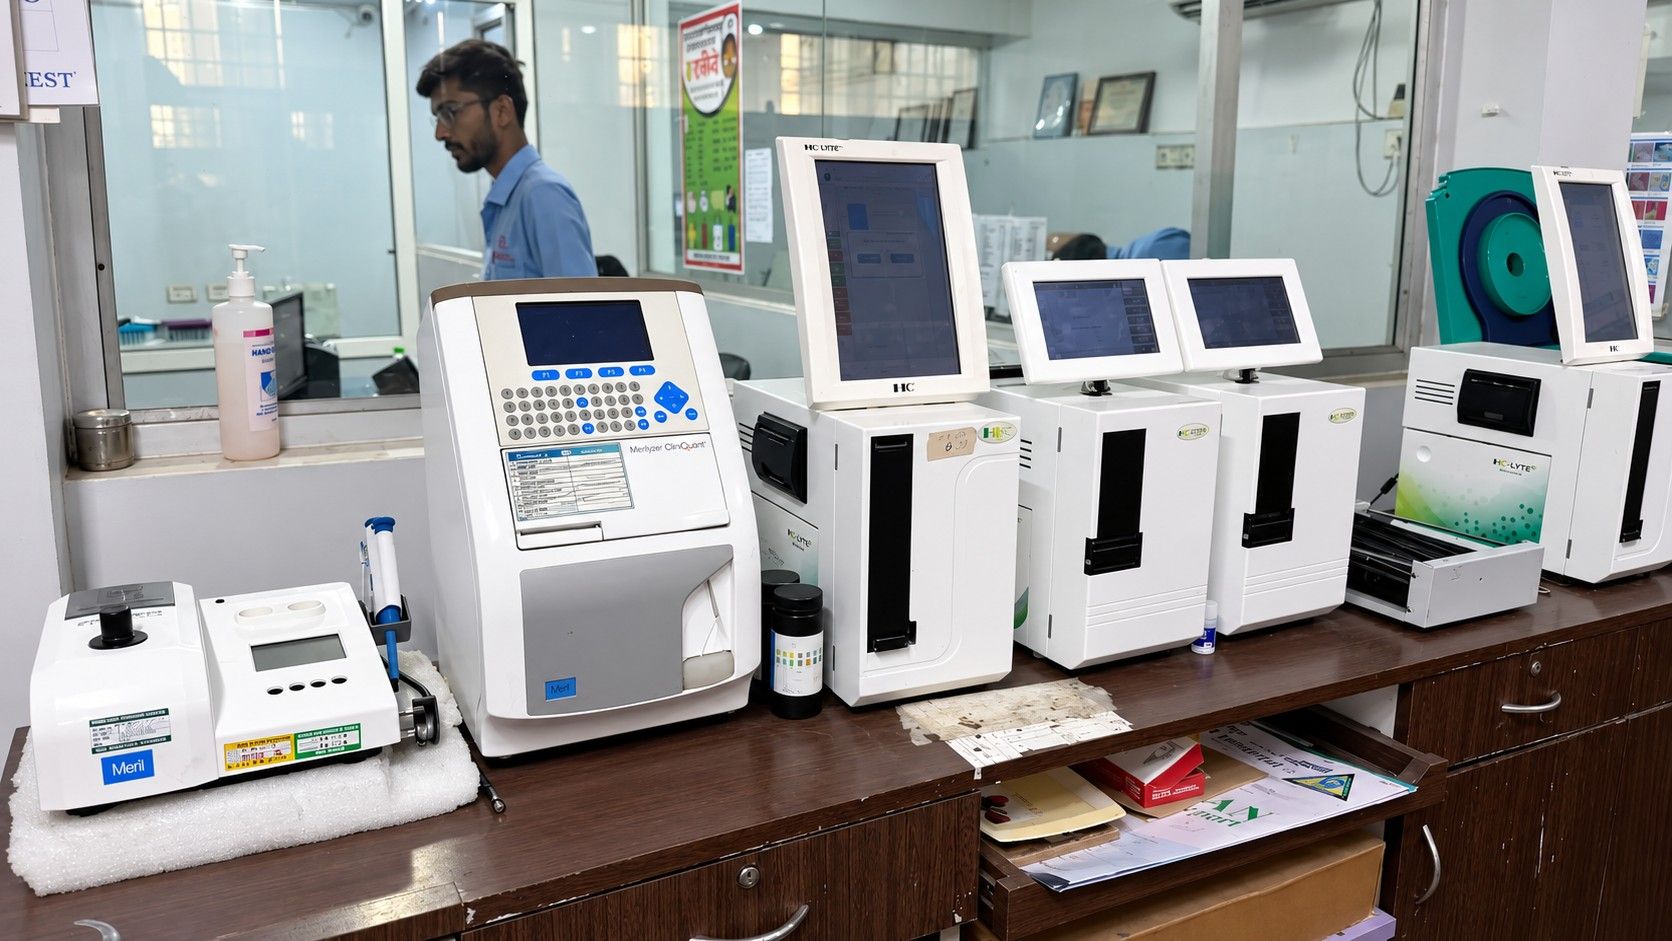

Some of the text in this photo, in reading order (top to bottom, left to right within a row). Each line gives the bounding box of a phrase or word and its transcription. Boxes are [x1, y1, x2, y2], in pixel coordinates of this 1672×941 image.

[24, 71, 73, 88] EST
[893, 382, 915, 393] HC
[112, 759, 145, 777] Meril
